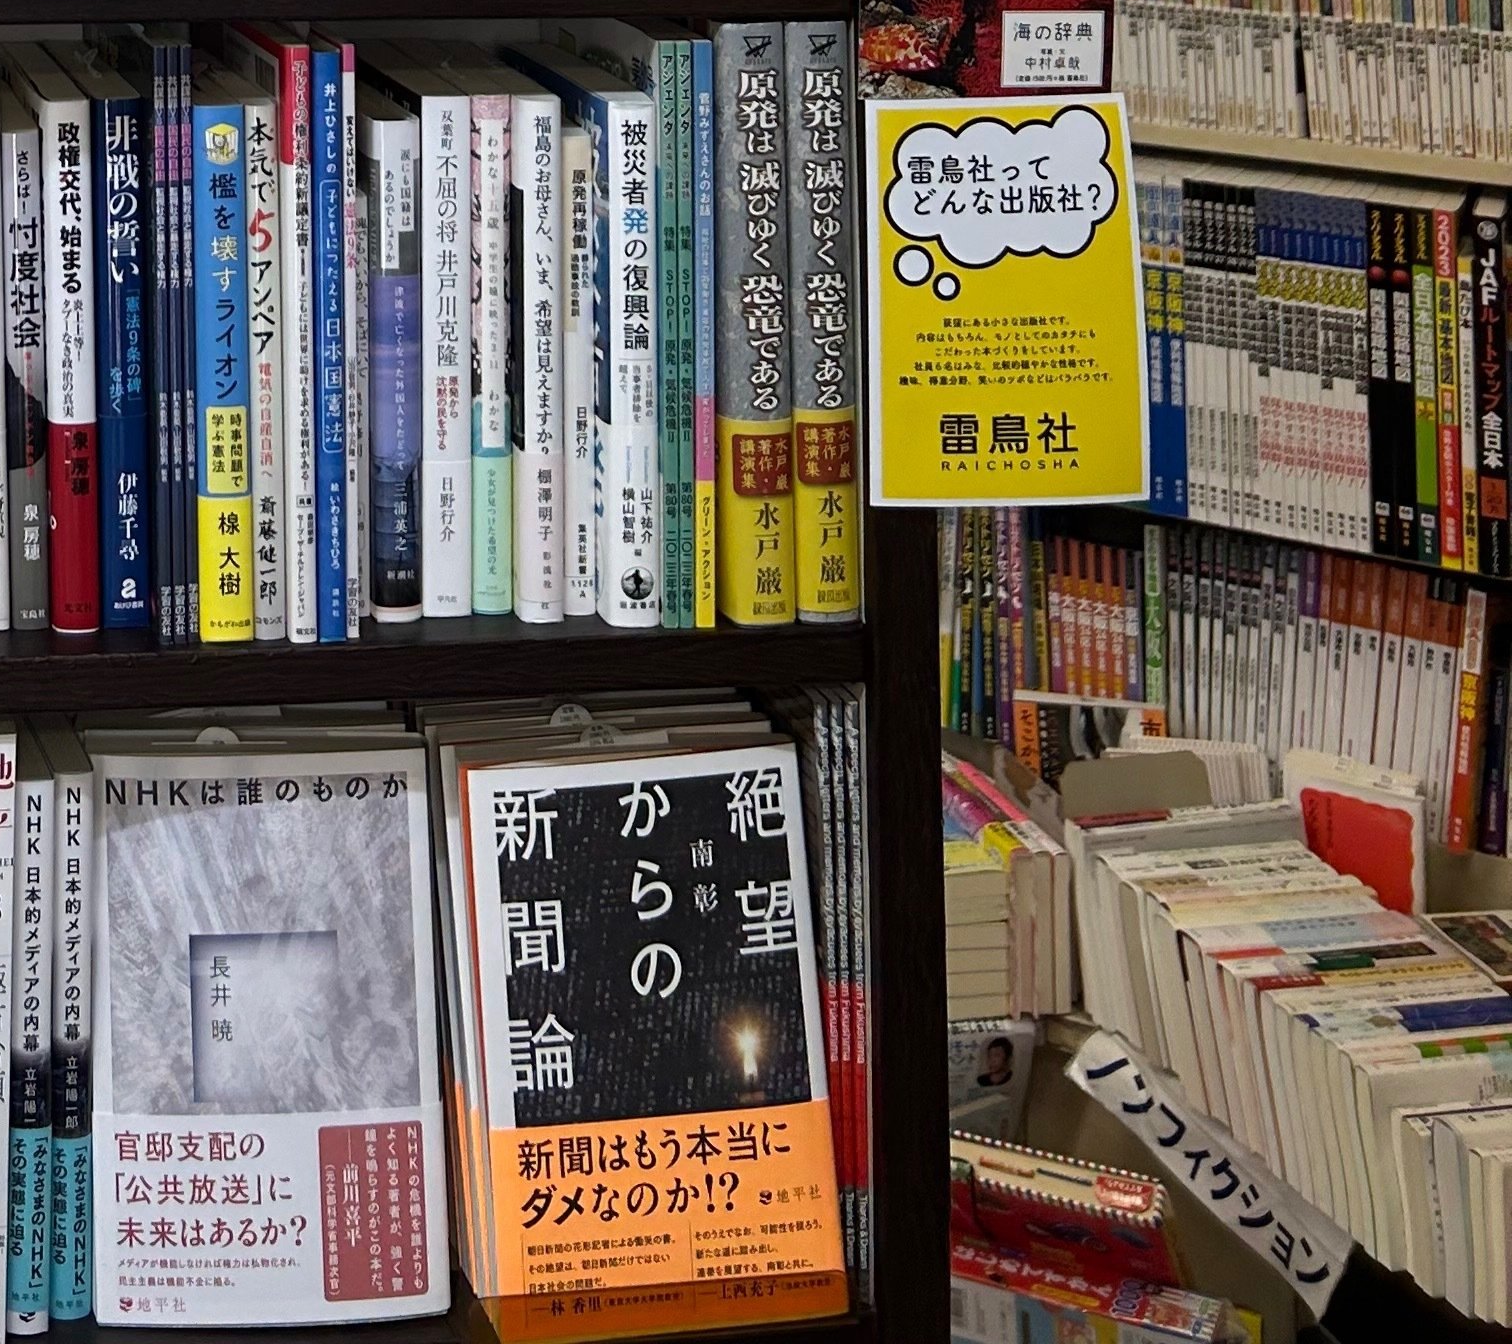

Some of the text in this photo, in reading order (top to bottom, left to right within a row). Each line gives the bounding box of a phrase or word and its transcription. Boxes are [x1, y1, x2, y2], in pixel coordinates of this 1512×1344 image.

[1012, 21, 1094, 43] 海の辞典
[58, 122, 83, 294] 政権交代、始まる
[105, 114, 140, 284] 非戦の誓い
[907, 154, 1052, 185] 雷鳥社って
[912, 183, 1103, 216] どんな出版社?
[9, 217, 42, 350] 忖度社会
[247, 116, 275, 358] 本気で5アンペア
[621, 119, 650, 352] 被災者発の復興論
[210, 171, 240, 400] 檻を壊すライオン
[322, 316, 344, 445] 日本国憲法
[939, 411, 1079, 456] 雷鳥社
[941, 458, 1080, 472] RAICHOSHA
[105, 772, 408, 807] NHKは誰のものか
[618, 780, 684, 999] からの
[724, 764, 799, 957] 絶望
[494, 786, 577, 1094] 新聞論
[113, 1172, 294, 1207] 「公共放送」に
[114, 1130, 266, 1163] 官邸支配の
[518, 1119, 792, 1182] 新聞はもう本当に
[117, 1215, 307, 1249] 未来はあるか?
